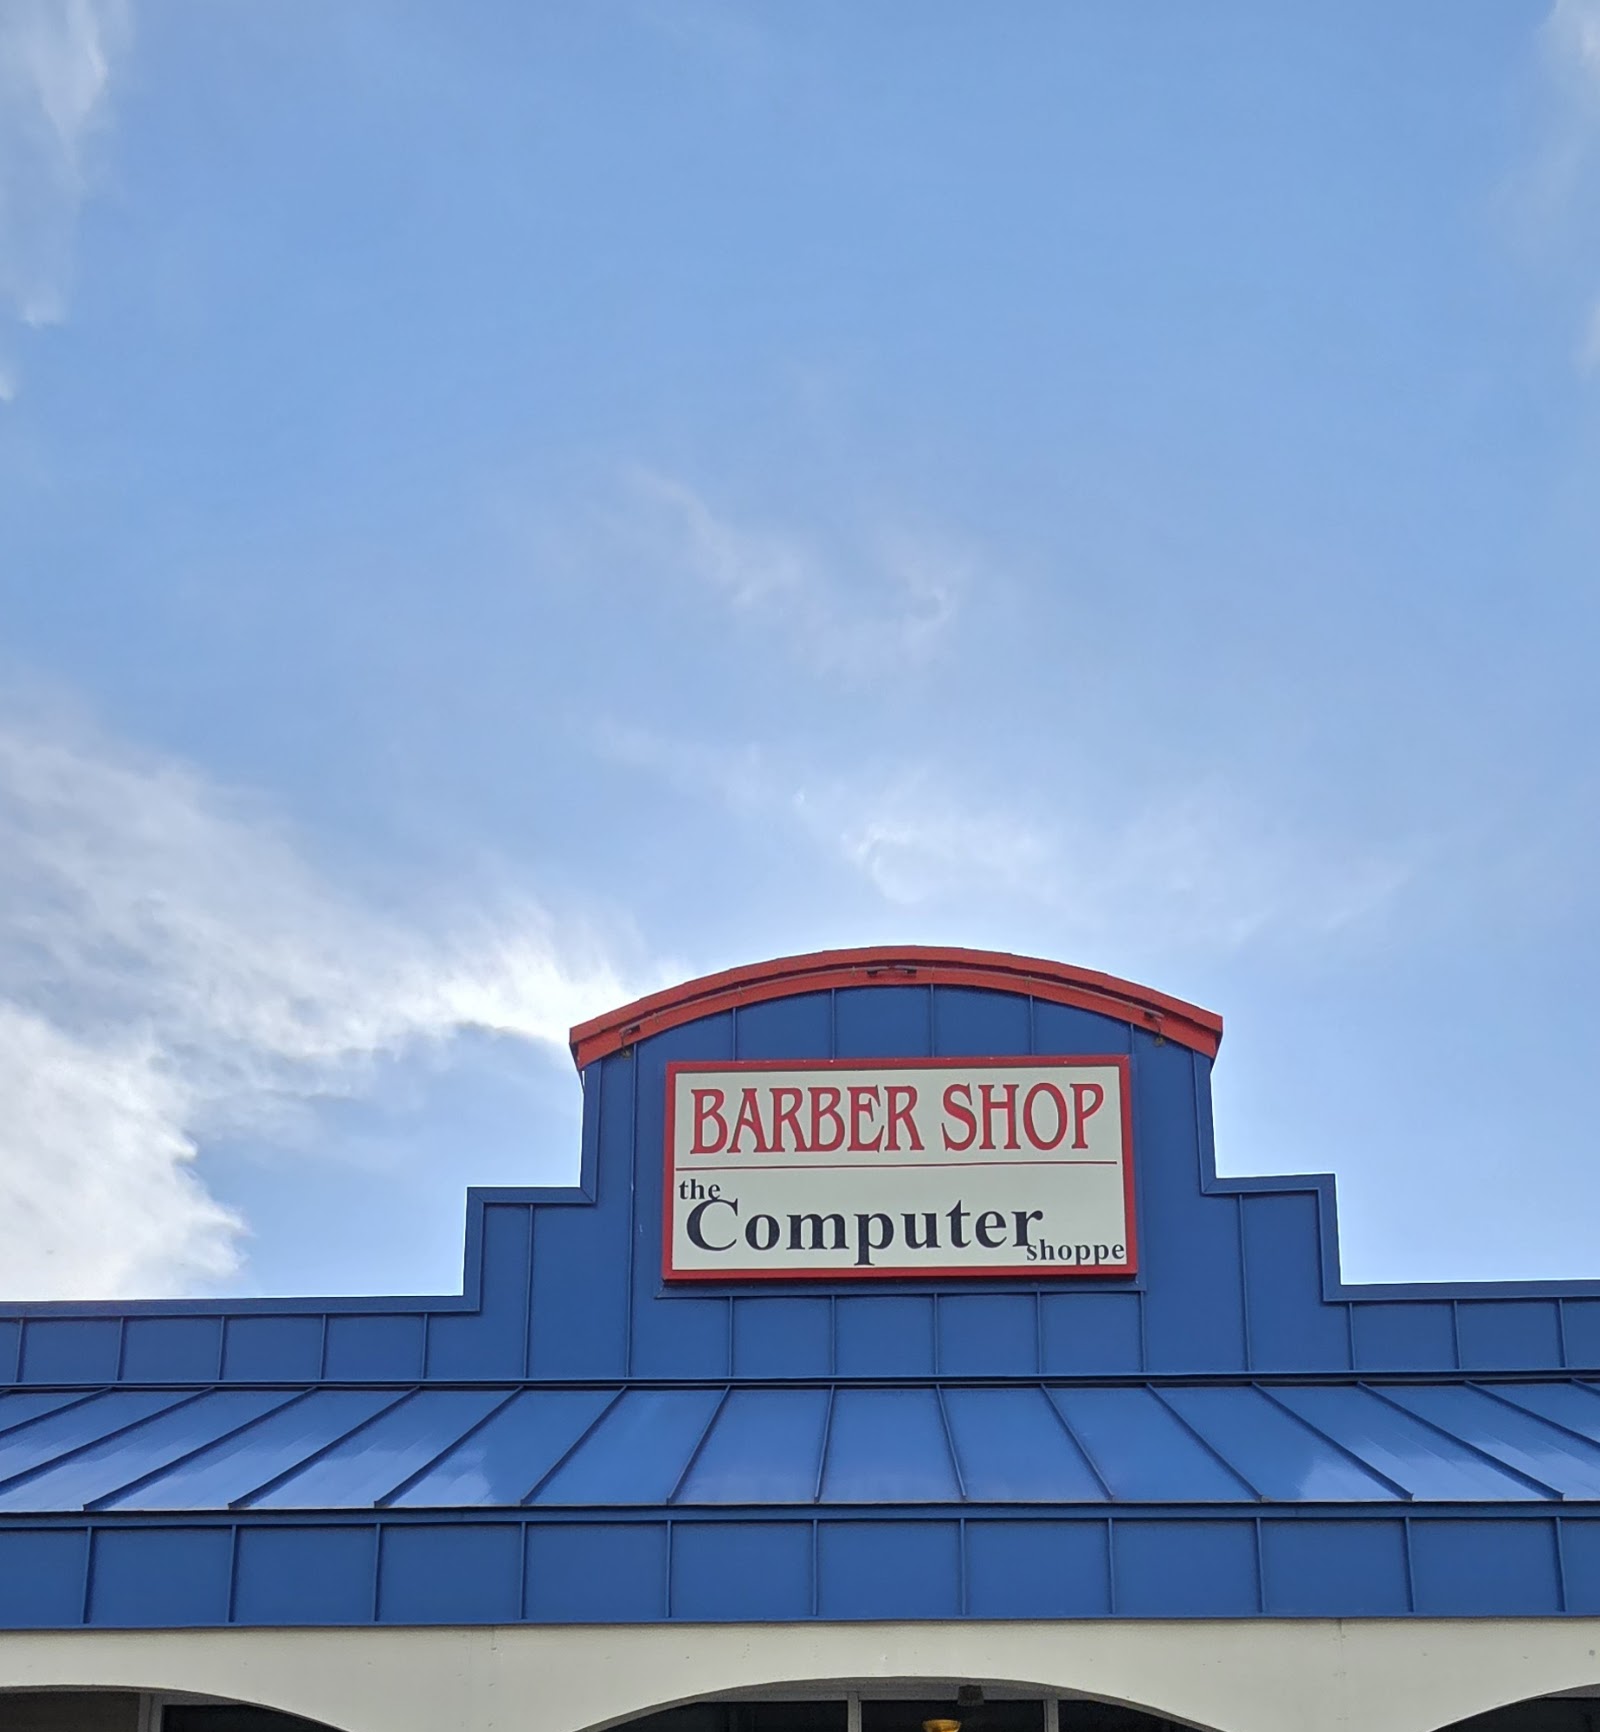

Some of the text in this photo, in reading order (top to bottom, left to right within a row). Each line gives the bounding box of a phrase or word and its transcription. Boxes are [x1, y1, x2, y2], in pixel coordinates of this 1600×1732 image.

[689, 1082, 1105, 1155] BARBER SHOP
[678, 1178, 722, 1203] the
[685, 1198, 1044, 1267] Computer
[1025, 1239, 1126, 1266] shoppe
